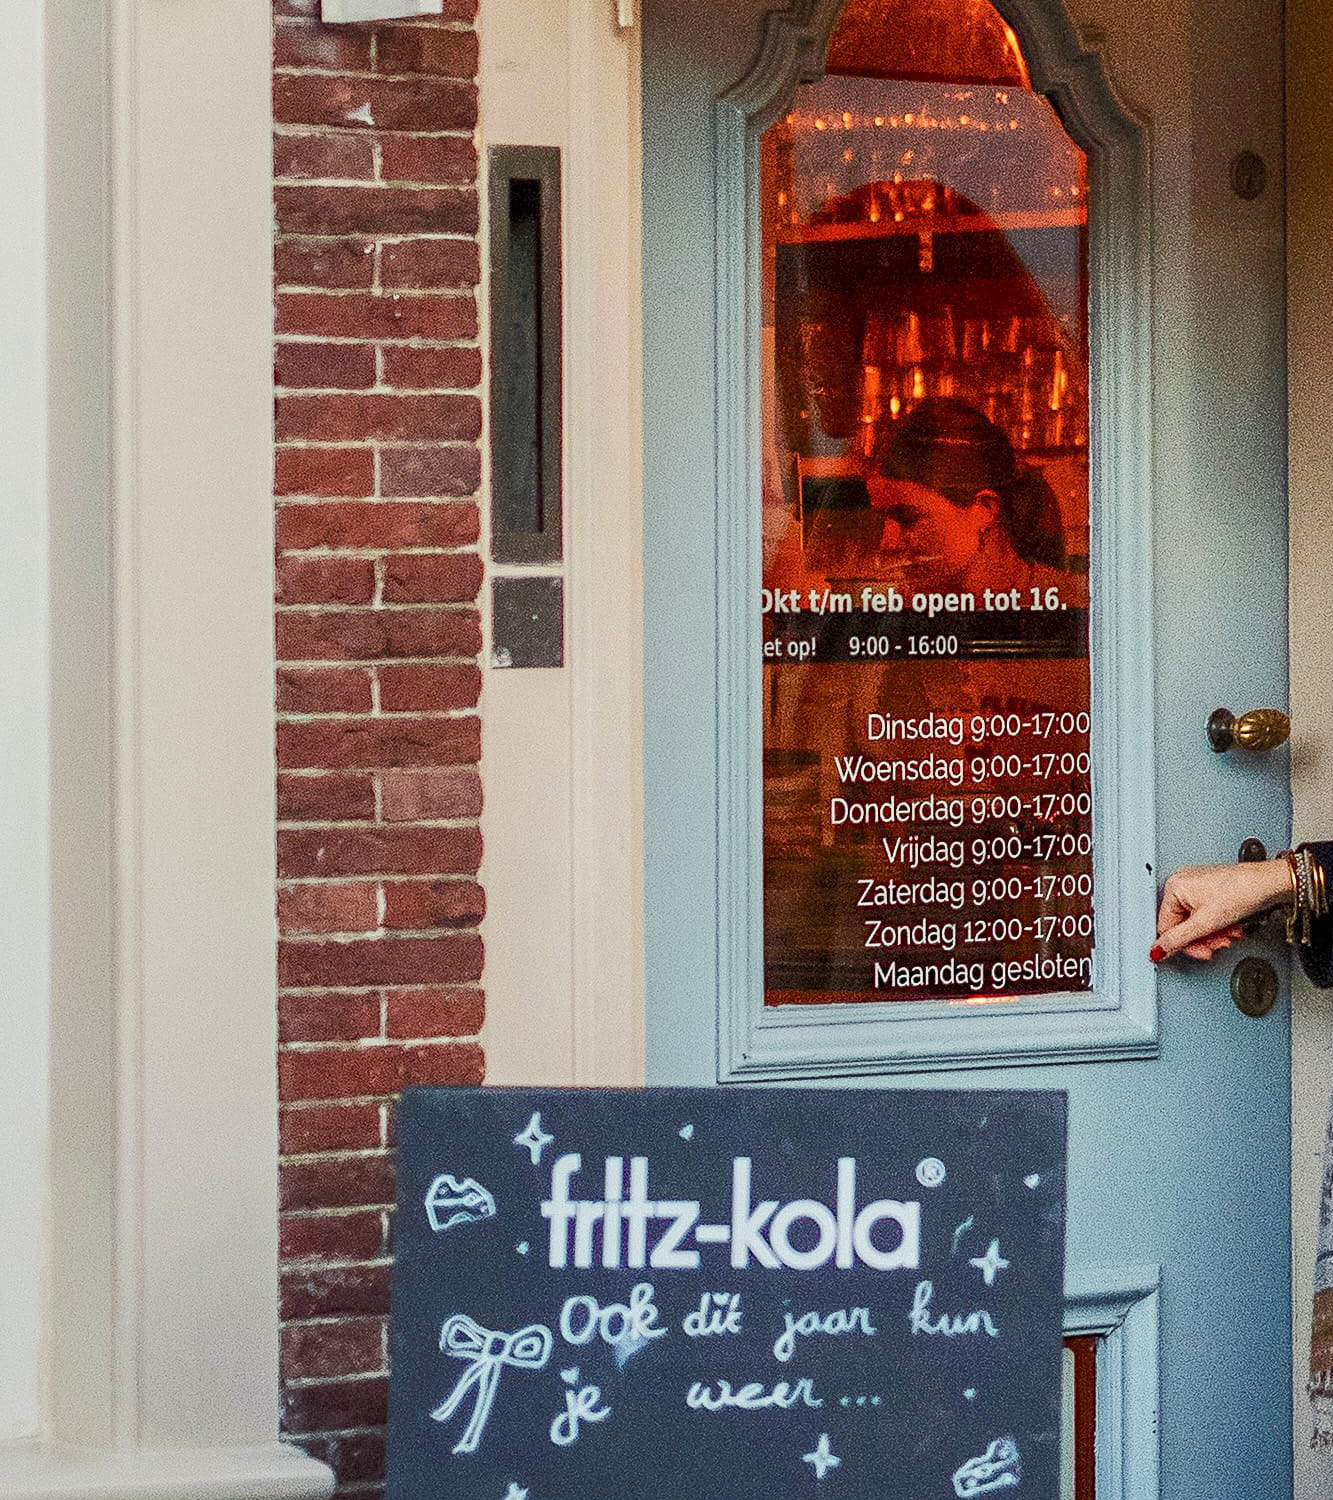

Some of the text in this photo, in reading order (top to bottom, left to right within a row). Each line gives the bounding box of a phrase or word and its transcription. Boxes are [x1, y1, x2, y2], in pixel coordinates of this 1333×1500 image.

[808, 588, 853, 615] t/m
[861, 587, 903, 613] feb
[912, 589, 976, 617] open
[984, 589, 1020, 612] tot
[1030, 586, 1068, 612] 16.
[762, 640, 783, 657] et
[786, 637, 817, 660] op!
[848, 636, 889, 656] 9:00
[907, 635, 959, 656] 16:00
[868, 710, 1091, 742] Dinsdag 9:00-17:00
[834, 751, 1092, 784] Woensdag 9:00-17:00
[831, 791, 1092, 826] Donderdag 9:00-17:00
[882, 832, 1092, 867] Vrijdag 9:00-17:00
[857, 872, 1092, 909] Zaterdag 9:00-17:00
[865, 914, 1093, 949] Zondag 12:00-17:00
[874, 954, 1093, 991] Maandag gesloten
[540, 1154, 920, 1270] fritz-kola
[560, 1281, 999, 1362] Ook dit jaar kun
[550, 1368, 611, 1446] je
